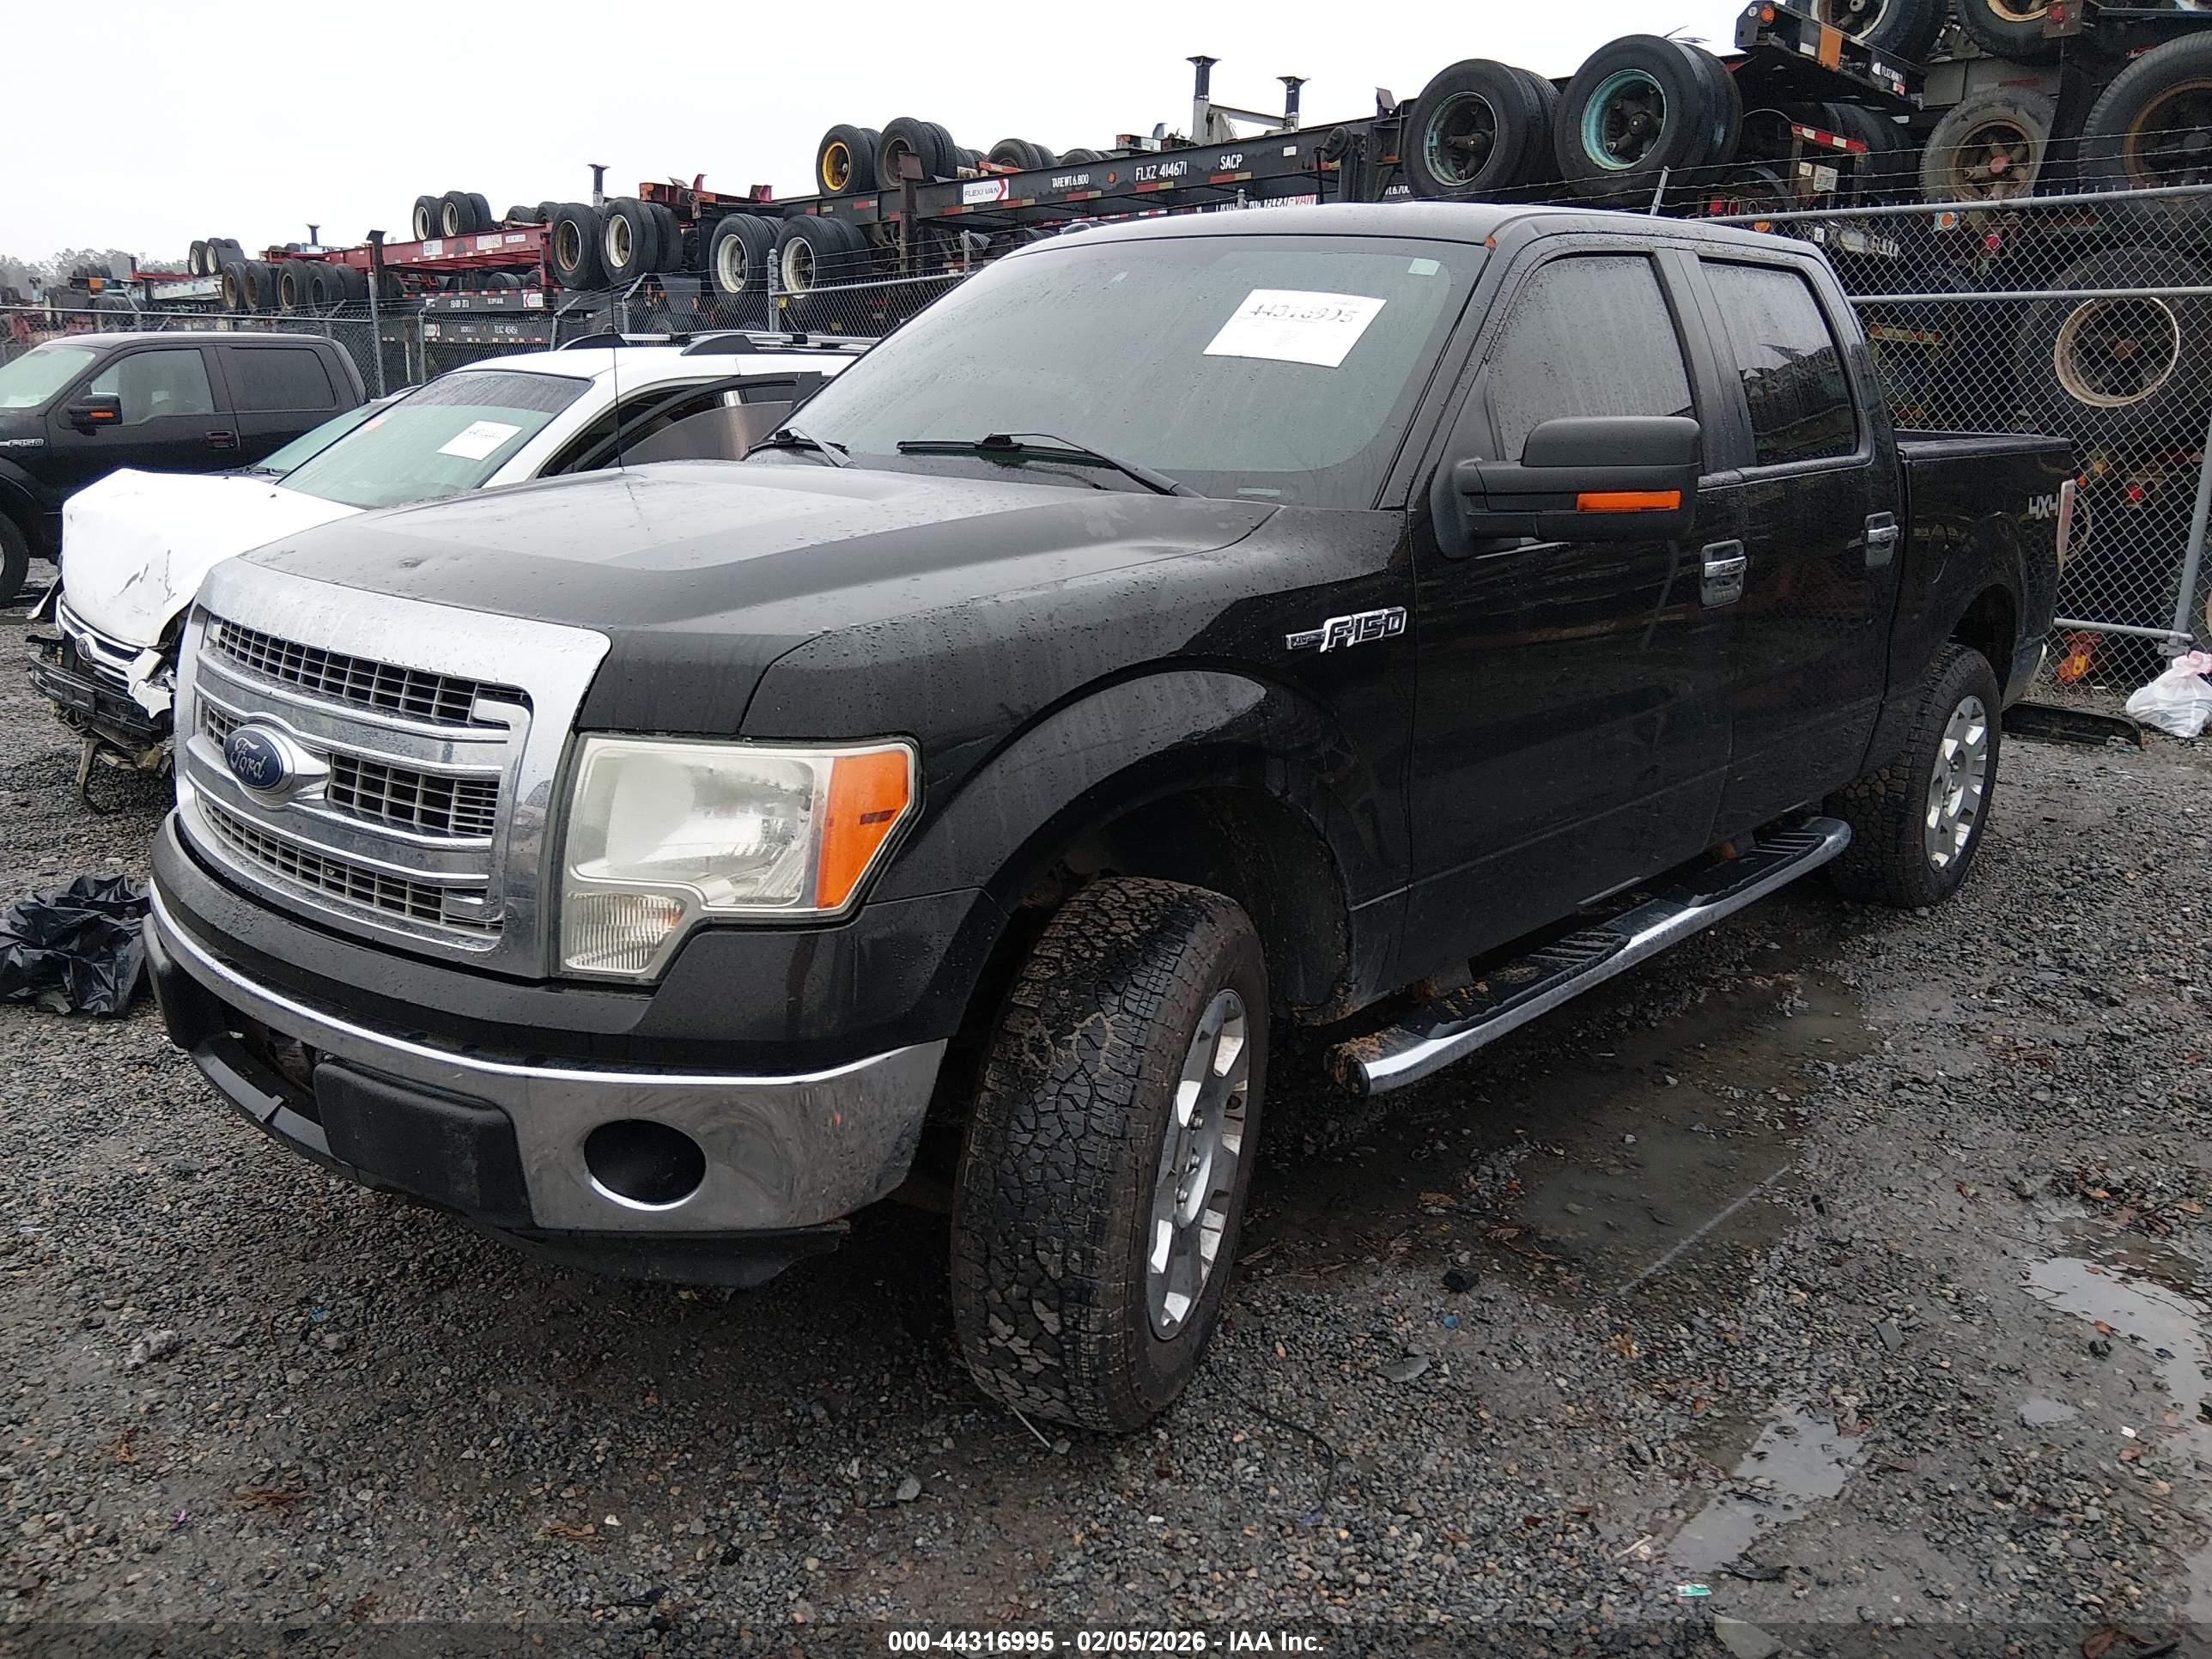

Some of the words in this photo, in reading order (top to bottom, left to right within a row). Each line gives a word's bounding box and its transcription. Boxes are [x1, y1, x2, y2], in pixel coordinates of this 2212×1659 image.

[1135, 165, 1157, 181] FLXZ
[1159, 161, 1188, 179] 414671
[1219, 154, 1243, 170] SACP
[963, 187, 984, 198] FLEXI
[984, 185, 1000, 196] VAN
[230, 737, 269, 781] Ford
